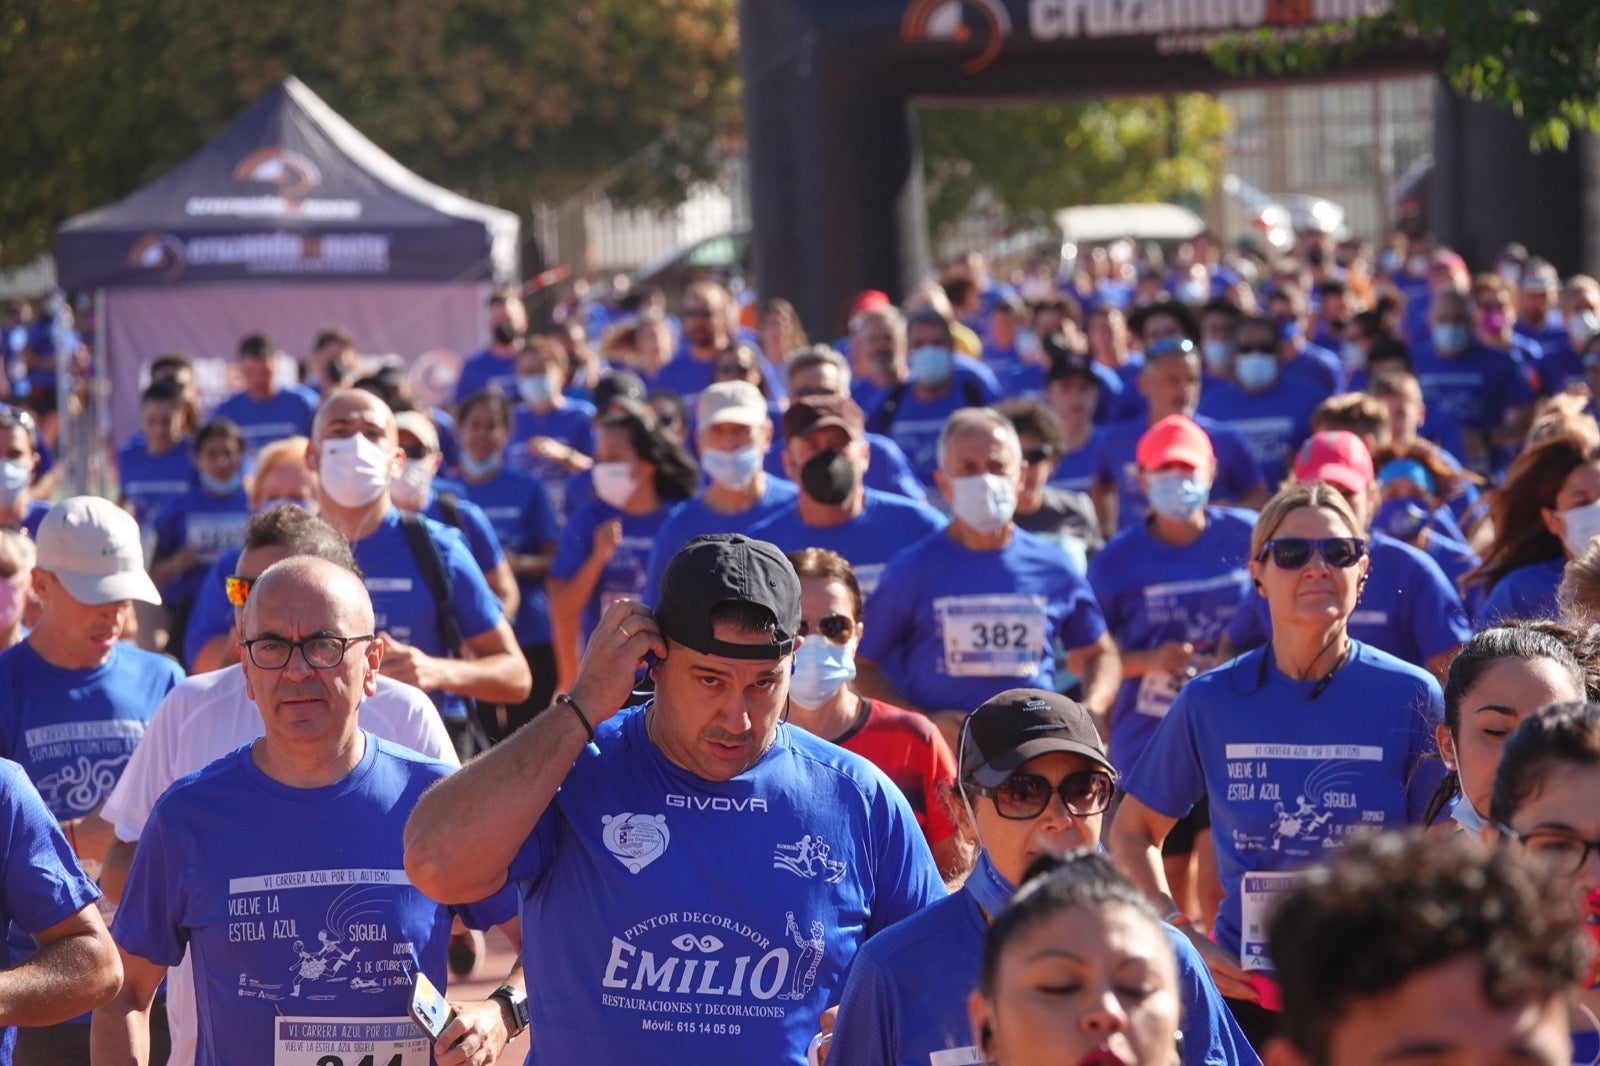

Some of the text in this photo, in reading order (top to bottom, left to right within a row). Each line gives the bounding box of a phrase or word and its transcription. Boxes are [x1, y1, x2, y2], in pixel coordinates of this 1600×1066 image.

[972, 623, 1028, 648] 382
[1227, 762, 1267, 778] VUELVE LA
[1228, 783, 1281, 800] ESTELA AZUL
[666, 794, 768, 812] GIVOVA
[264, 870, 390, 888] VI CARRERA AZUL POR EL AUTISMO
[228, 896, 280, 916] VUELVE LA
[229, 920, 299, 942] ESTELA AZUL
[350, 922, 387, 942] SÍGUELA
[624, 912, 770, 949] PINTOR DECORADOR
[356, 962, 361, 973] 3
[364, 962, 372, 973] DE
[376, 960, 400, 972] OCTUBRE
[602, 936, 789, 1000] EMILIO
[602, 994, 784, 1018] RESTAURACIONES Y DECORACIONES
[288, 1025, 298, 1038] VI
[302, 1024, 337, 1038] CARRERA
[342, 1025, 361, 1038] AZUL
[366, 1025, 380, 1038] POR
[384, 1025, 392, 1037] EL
[642, 1020, 741, 1035] Móvil: 615 14 05 09
[285, 1042, 304, 1052] VUELVE
[306, 1042, 314, 1052] LA
[316, 1042, 335, 1052] ESTELA
[338, 1042, 350, 1052] AZUL
